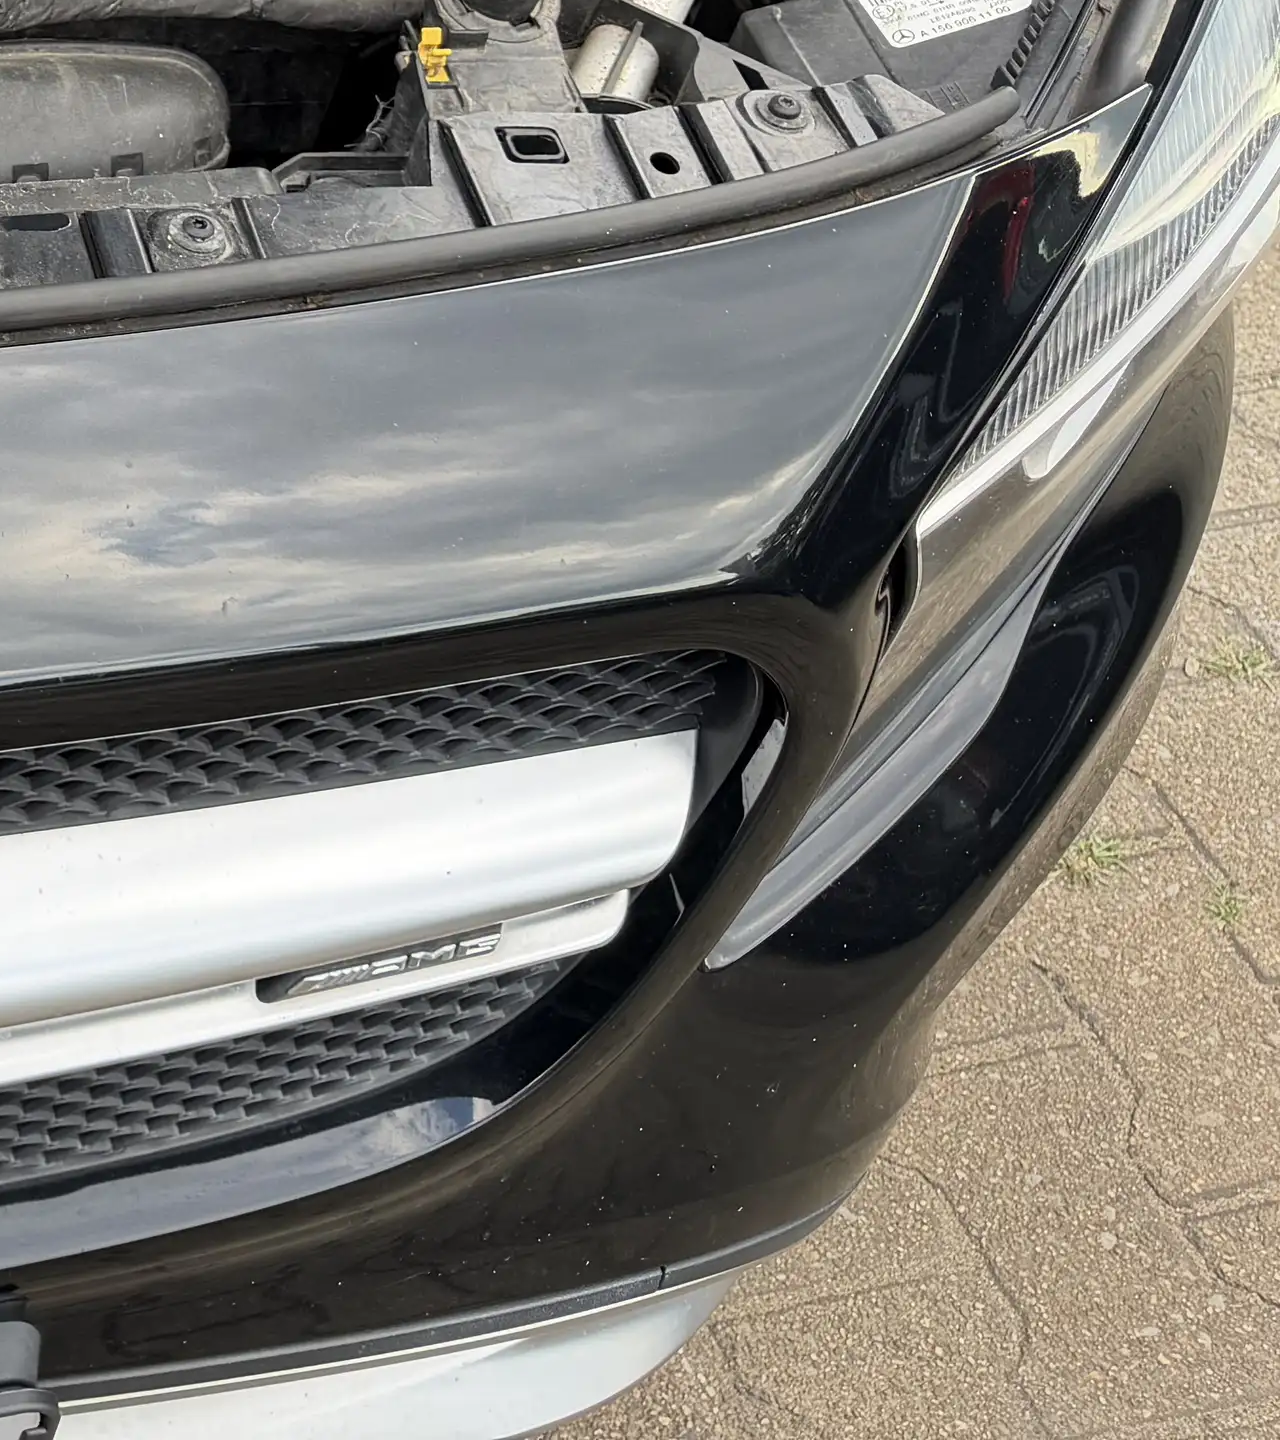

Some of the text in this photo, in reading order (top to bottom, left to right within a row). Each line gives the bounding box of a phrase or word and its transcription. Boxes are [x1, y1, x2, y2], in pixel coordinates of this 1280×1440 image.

[932, 23, 953, 33] 156
[954, 16, 976, 26] 906
[995, 6, 1011, 14] 00
